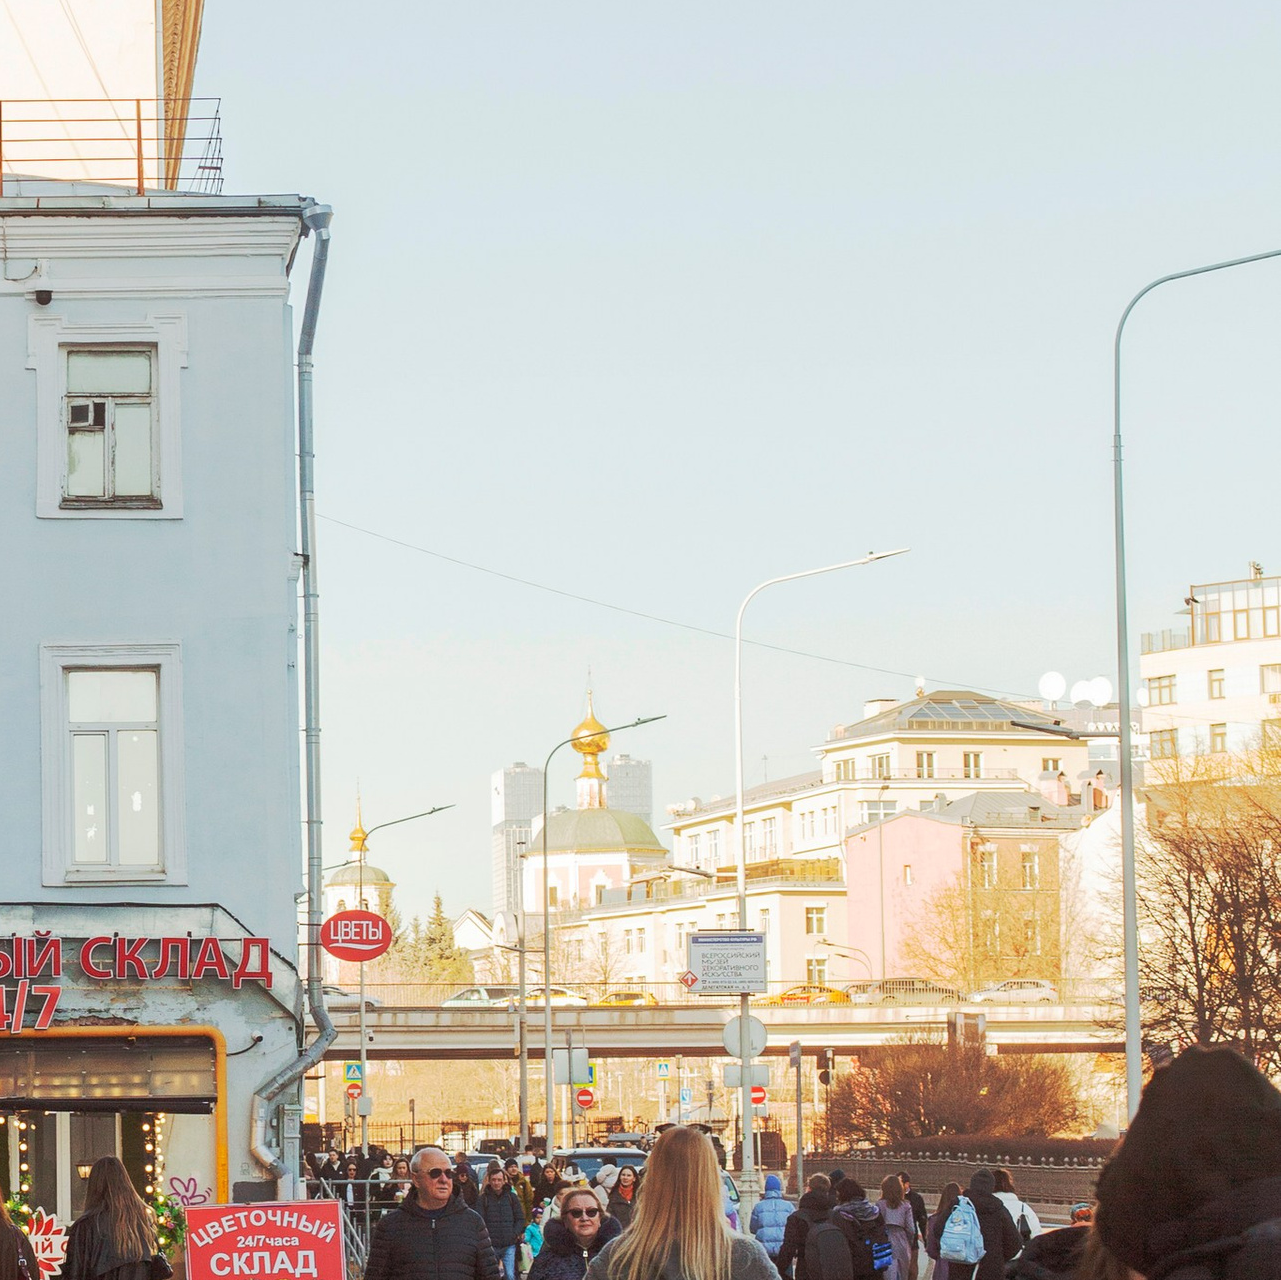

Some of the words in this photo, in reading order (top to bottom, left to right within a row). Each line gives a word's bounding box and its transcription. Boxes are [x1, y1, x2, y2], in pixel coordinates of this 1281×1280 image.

[330, 920, 383, 944] ЦВЕТЫ
[80, 935, 273, 990] СКЛАД
[191, 1209, 336, 1248] ЦВЕТОЧНЫЙ
[236, 1235, 299, 1248] 24/7часа
[209, 1250, 318, 1278] СКЛАД
